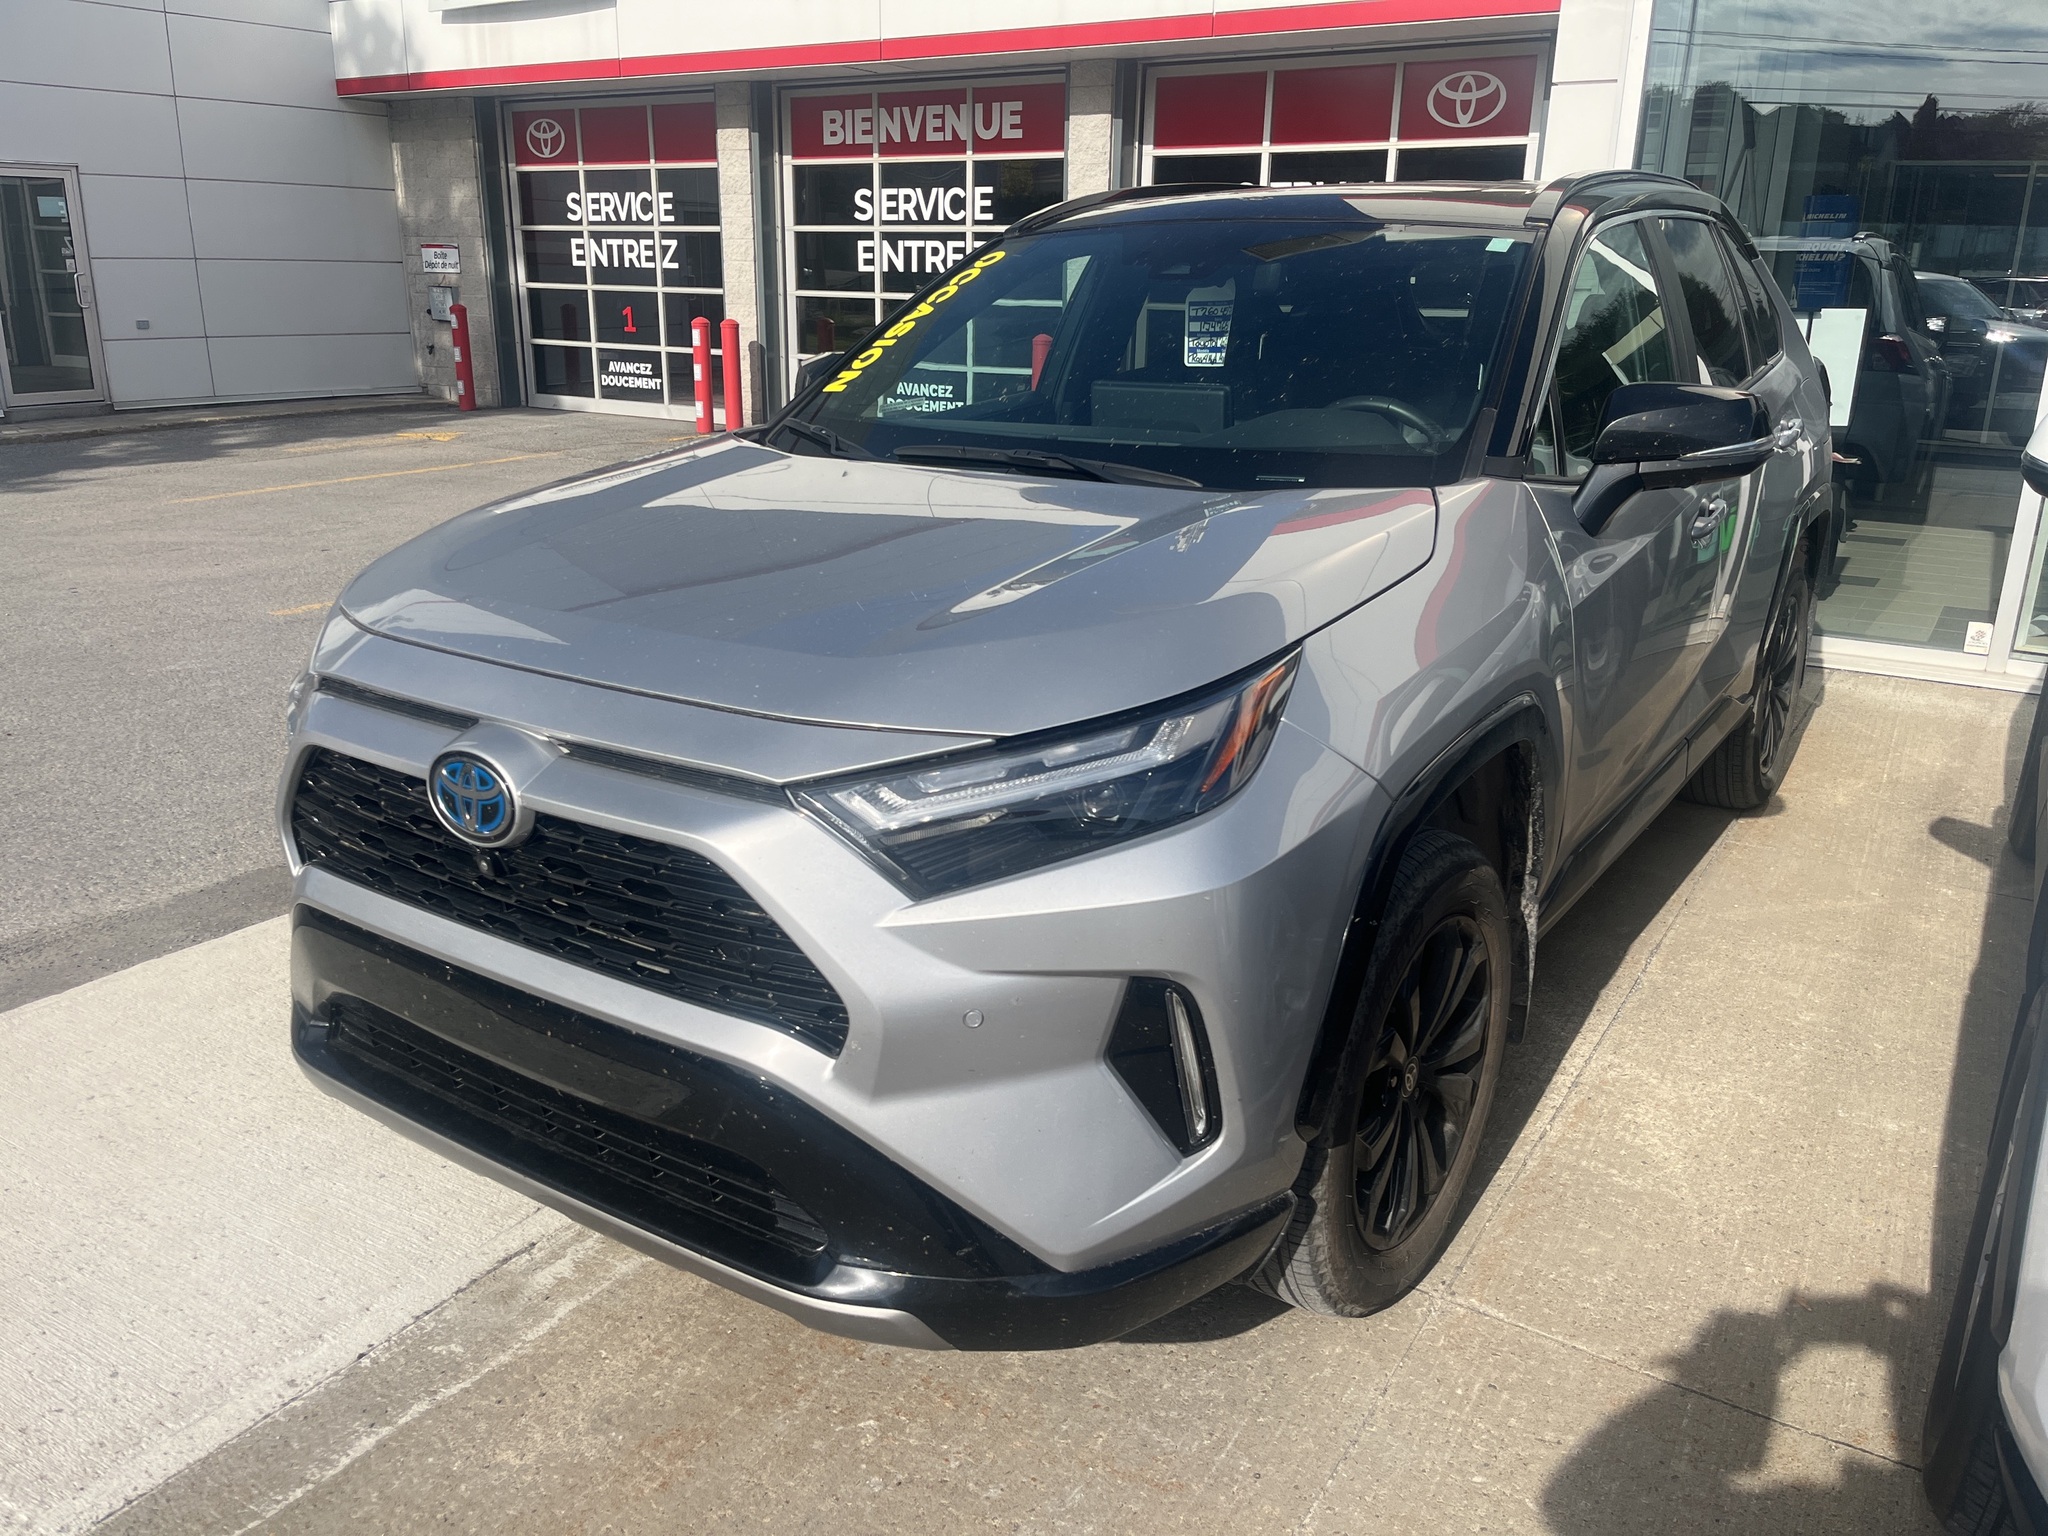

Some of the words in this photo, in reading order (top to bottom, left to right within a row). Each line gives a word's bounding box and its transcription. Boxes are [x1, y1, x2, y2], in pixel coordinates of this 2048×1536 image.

[823, 101, 1023, 145] BIENVENUE
[566, 191, 675, 222] SERVICE
[853, 186, 994, 222] SERVICE
[424, 260, 440, 270] Dépôt
[441, 260, 448, 269] de
[433, 250, 448, 260] Boîte
[570, 238, 679, 269] ENTREZ
[857, 239, 988, 274] ENTRE
[622, 305, 637, 333] 1
[822, 251, 1006, 393] OCCASION
[601, 374, 662, 390] DOUCEMENT
[608, 360, 653, 376] AVANCEZ
[896, 382, 954, 398] AVANCEZ
